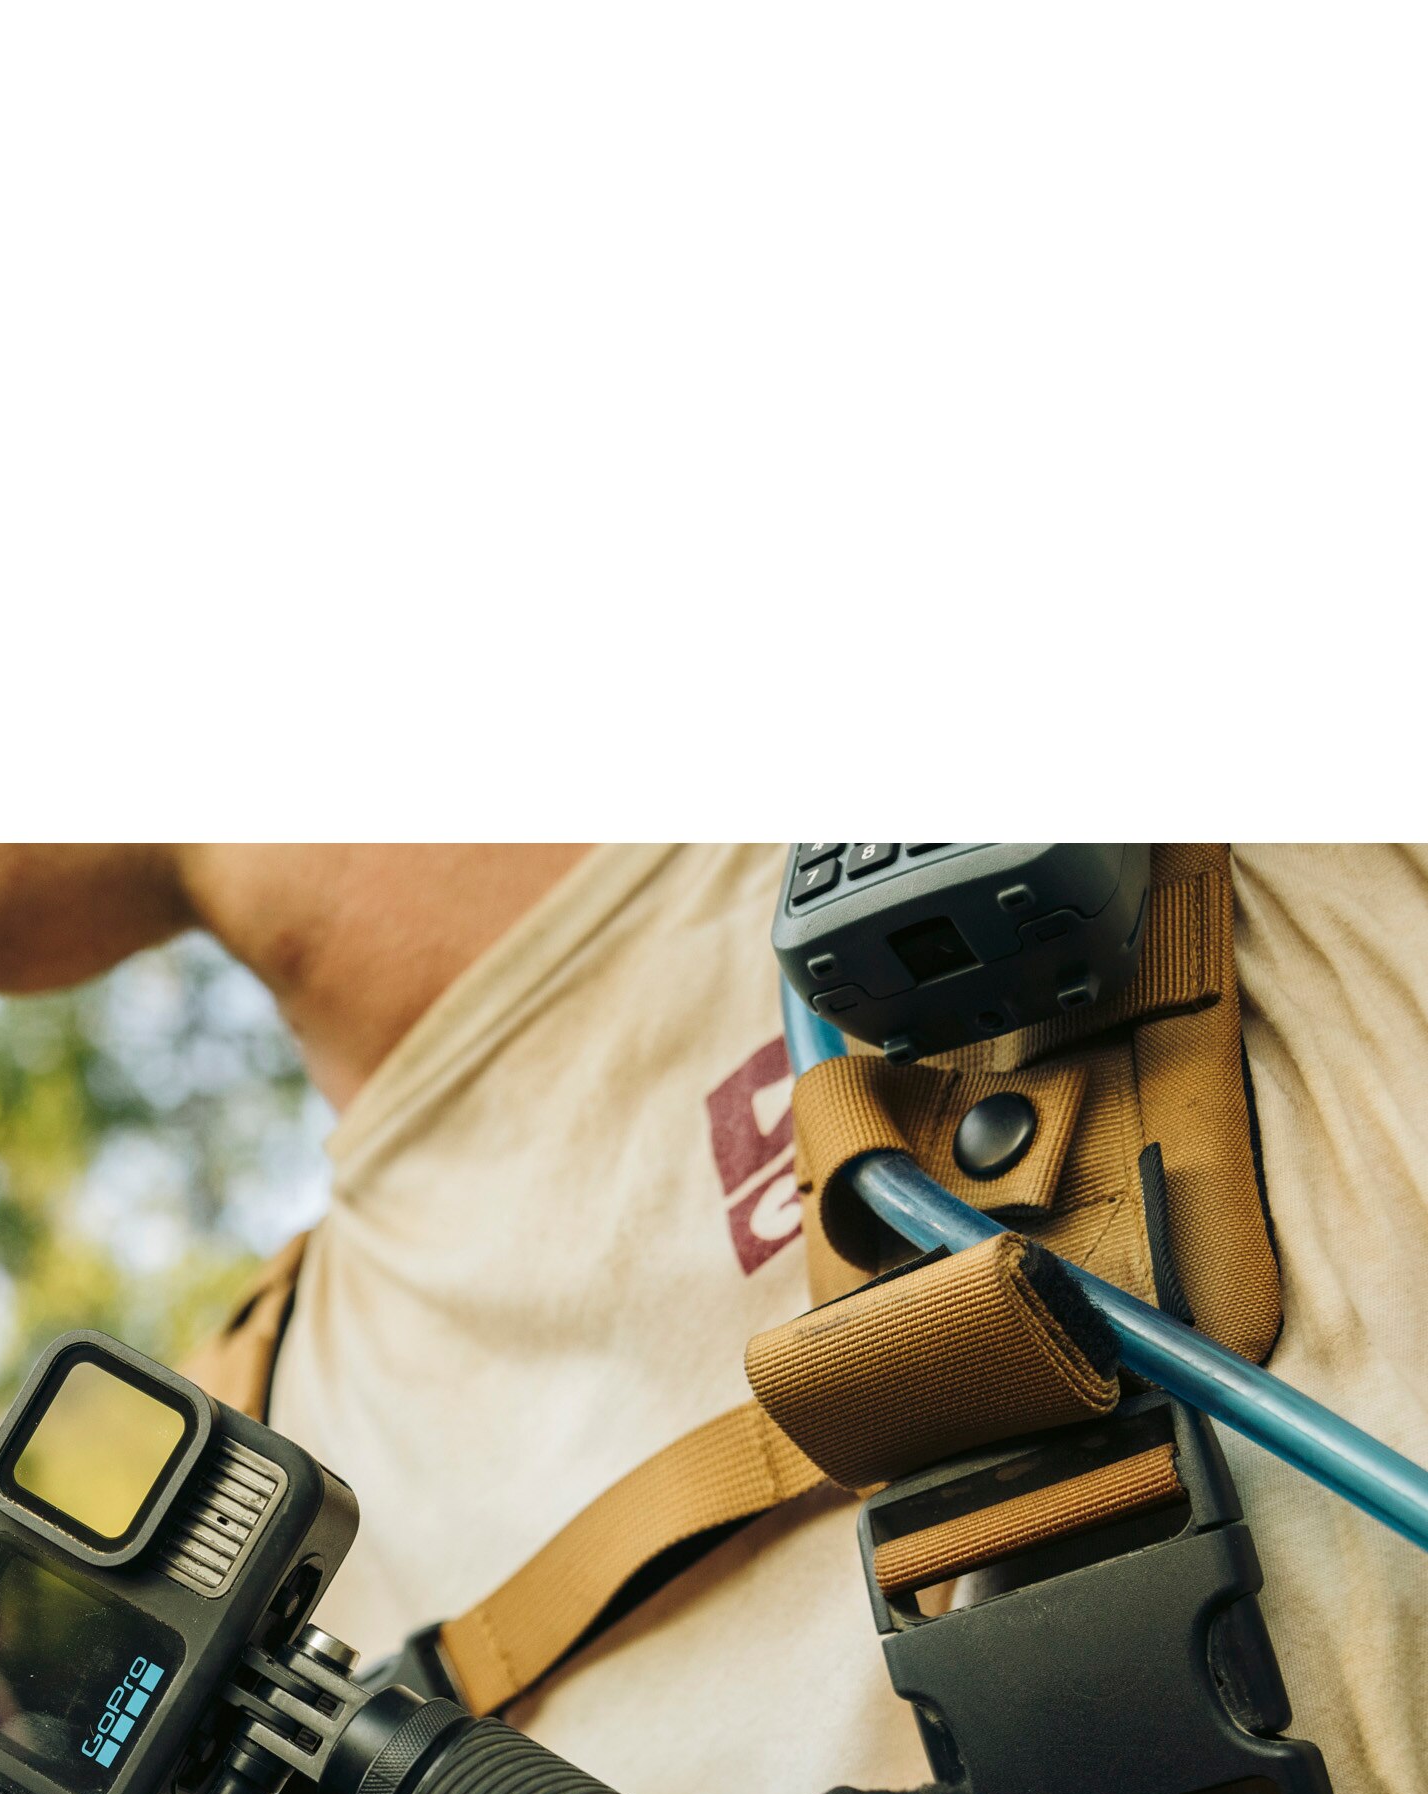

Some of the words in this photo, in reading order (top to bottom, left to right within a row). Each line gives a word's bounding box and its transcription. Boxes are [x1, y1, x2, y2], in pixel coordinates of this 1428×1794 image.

[862, 844, 876, 860] 8
[807, 869, 819, 885] 7
[81, 1656, 148, 1758] GoPro
